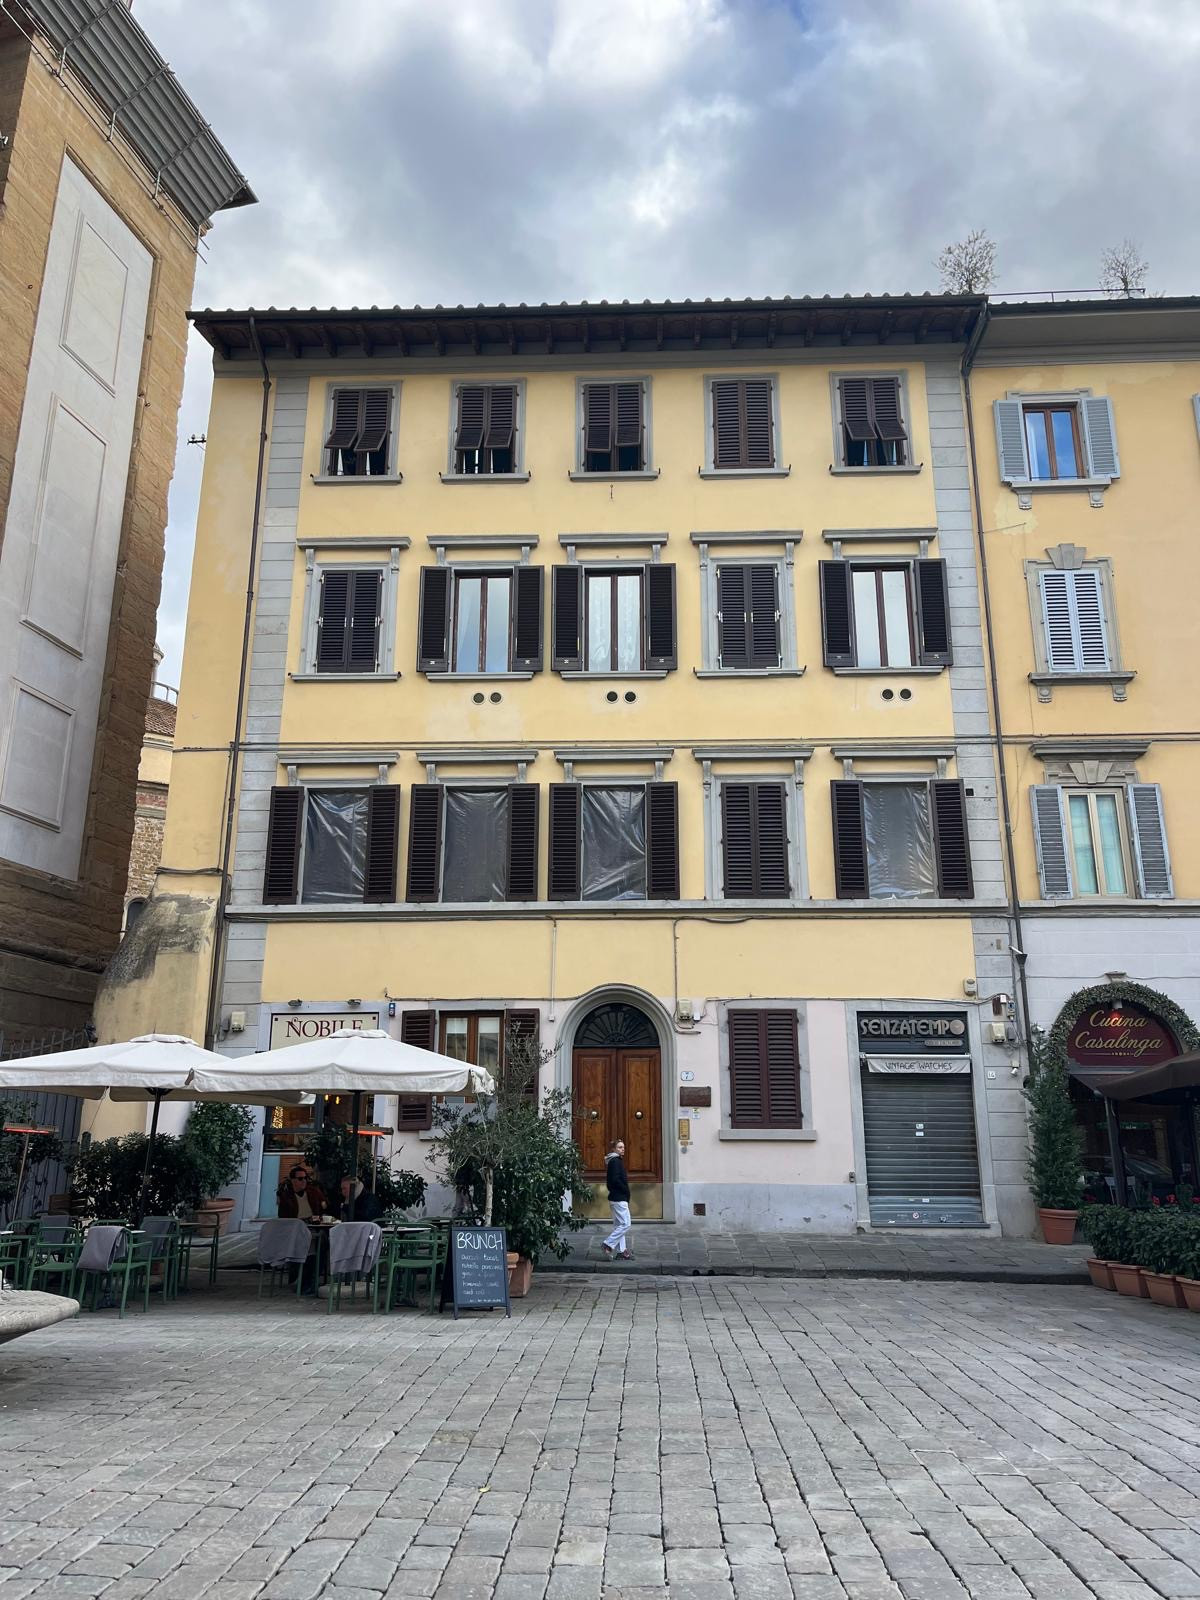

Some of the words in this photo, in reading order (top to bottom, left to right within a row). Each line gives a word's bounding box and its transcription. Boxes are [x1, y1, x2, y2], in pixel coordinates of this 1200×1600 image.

[860, 1019, 965, 1035] SENZATEMPO
[1089, 1010, 1148, 1027] Cucina
[1075, 1029, 1163, 1057] Casalinga
[885, 1061, 916, 1070] VINTAGE
[918, 1061, 953, 1070] WATCHES
[457, 1232, 503, 1250] BRUNCH
